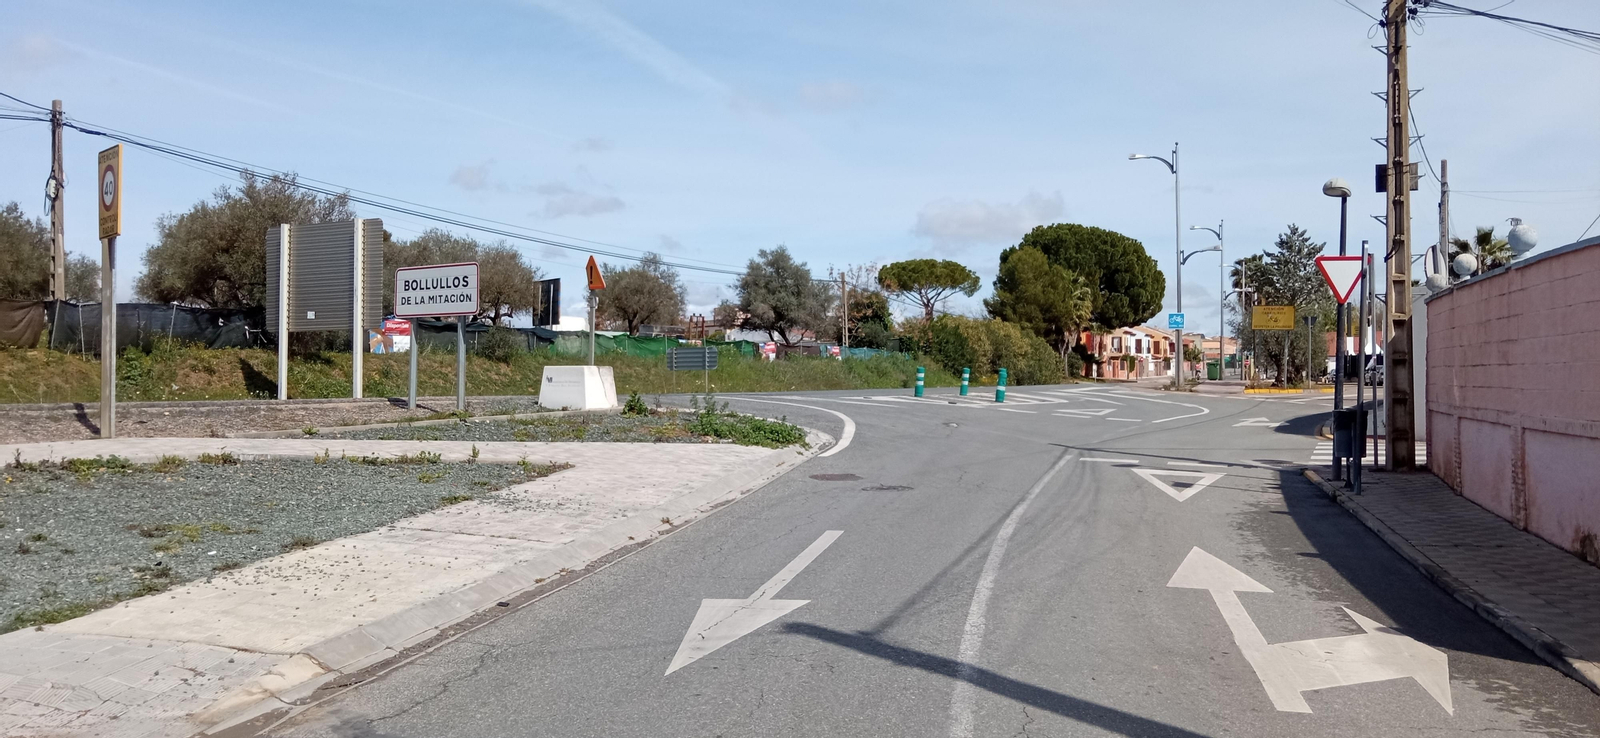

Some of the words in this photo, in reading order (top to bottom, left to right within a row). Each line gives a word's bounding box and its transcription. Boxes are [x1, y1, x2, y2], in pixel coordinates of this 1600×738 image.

[104, 181, 113, 197] 40
[404, 275, 469, 291] BOLLULLOS
[400, 296, 412, 306] DE
[414, 296, 426, 305] LA
[428, 292, 472, 305] MITACIÓN
